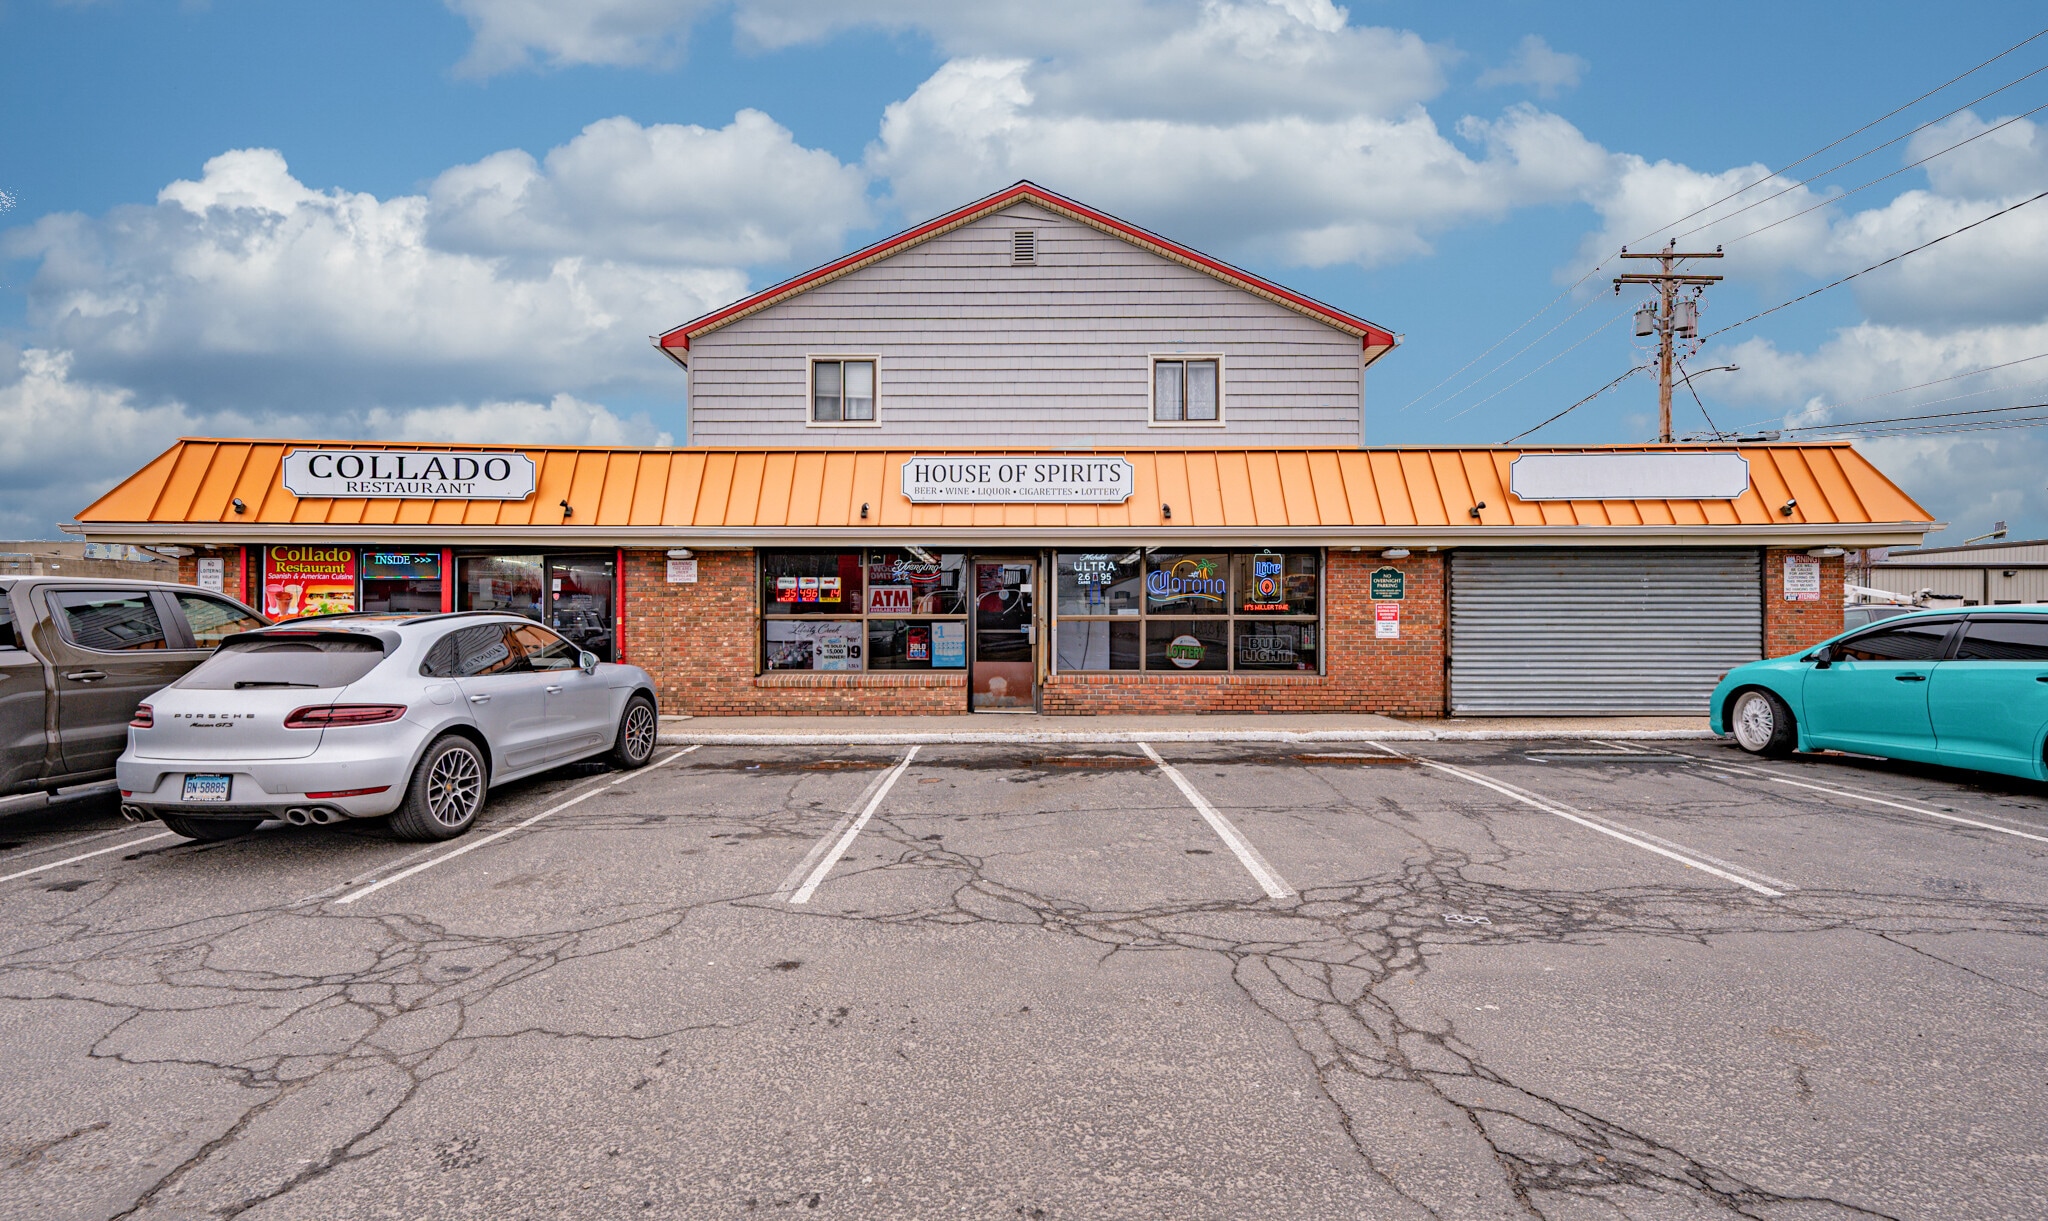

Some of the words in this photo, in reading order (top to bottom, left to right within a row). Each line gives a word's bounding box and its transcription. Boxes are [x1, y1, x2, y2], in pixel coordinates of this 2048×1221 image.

[308, 454, 511, 481] COLLADO
[914, 464, 991, 483] HOUSE
[998, 464, 1028, 483] OF
[1034, 463, 1121, 482] SPIRITS
[346, 481, 476, 494] RESTAURANT
[914, 487, 937, 495] BEER
[945, 487, 970, 495] WINE
[977, 487, 1011, 497] LIQUOR
[1018, 487, 1073, 496] CIGARETTES
[1081, 487, 1121, 496] LOTTERY
[271, 546, 351, 562] Collado
[374, 555, 411, 565] INSIDE
[276, 562, 346, 573] Restaurant
[1073, 561, 1117, 571] ULTRA
[1255, 561, 1281, 577] Lite
[1147, 570, 1227, 596] Corona
[784, 588, 797, 598] 35
[799, 588, 818, 598] 496
[871, 590, 909, 606] ATM
[1249, 638, 1284, 650] BUD
[1166, 645, 1206, 659] LOTTERY
[1241, 650, 1290, 662] LIGHT
